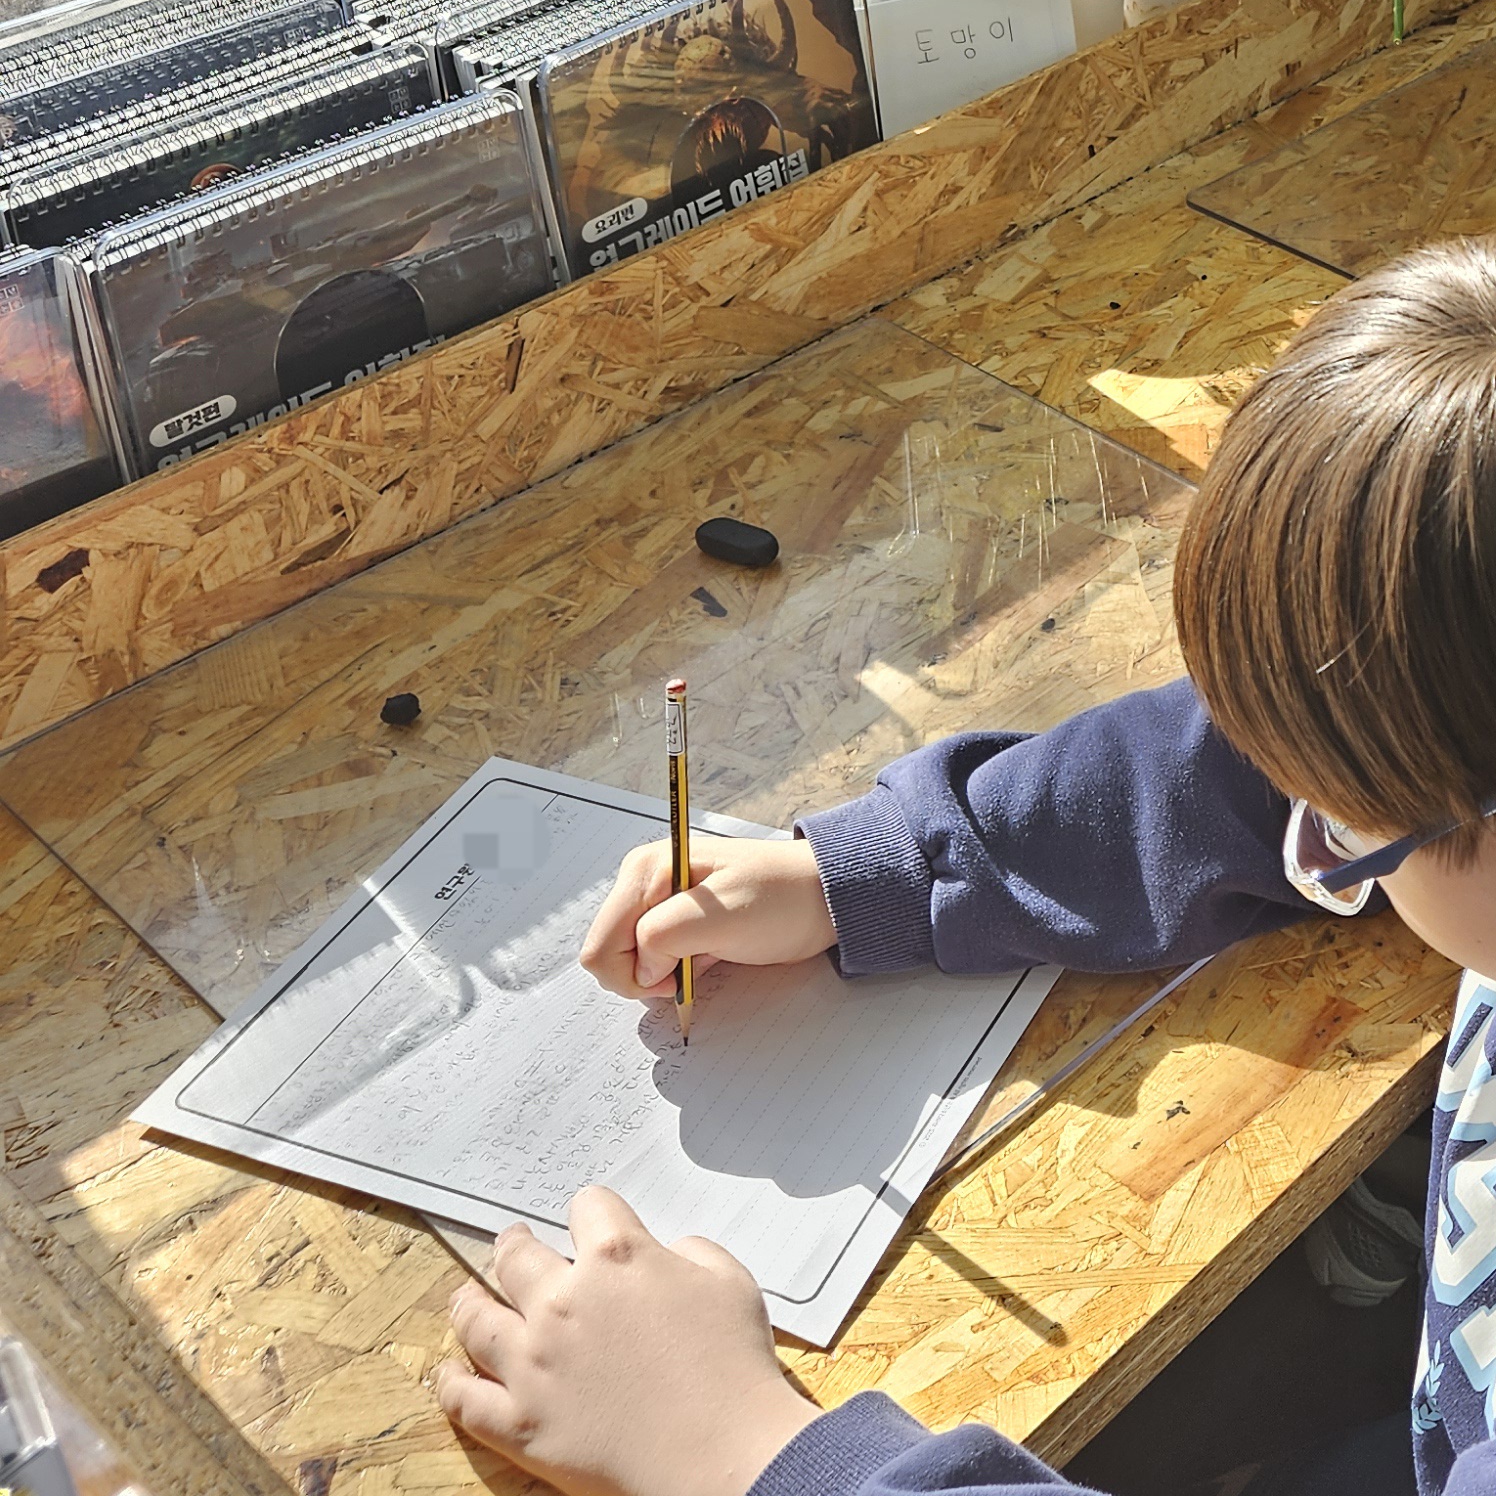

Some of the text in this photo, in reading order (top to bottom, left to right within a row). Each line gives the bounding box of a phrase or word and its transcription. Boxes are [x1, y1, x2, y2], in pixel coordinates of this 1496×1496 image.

[915, 17, 1016, 65] 토망이
[729, 149, 810, 208] 어휘집
[594, 204, 635, 235] 요리편
[164, 401, 222, 440] 탈것편
